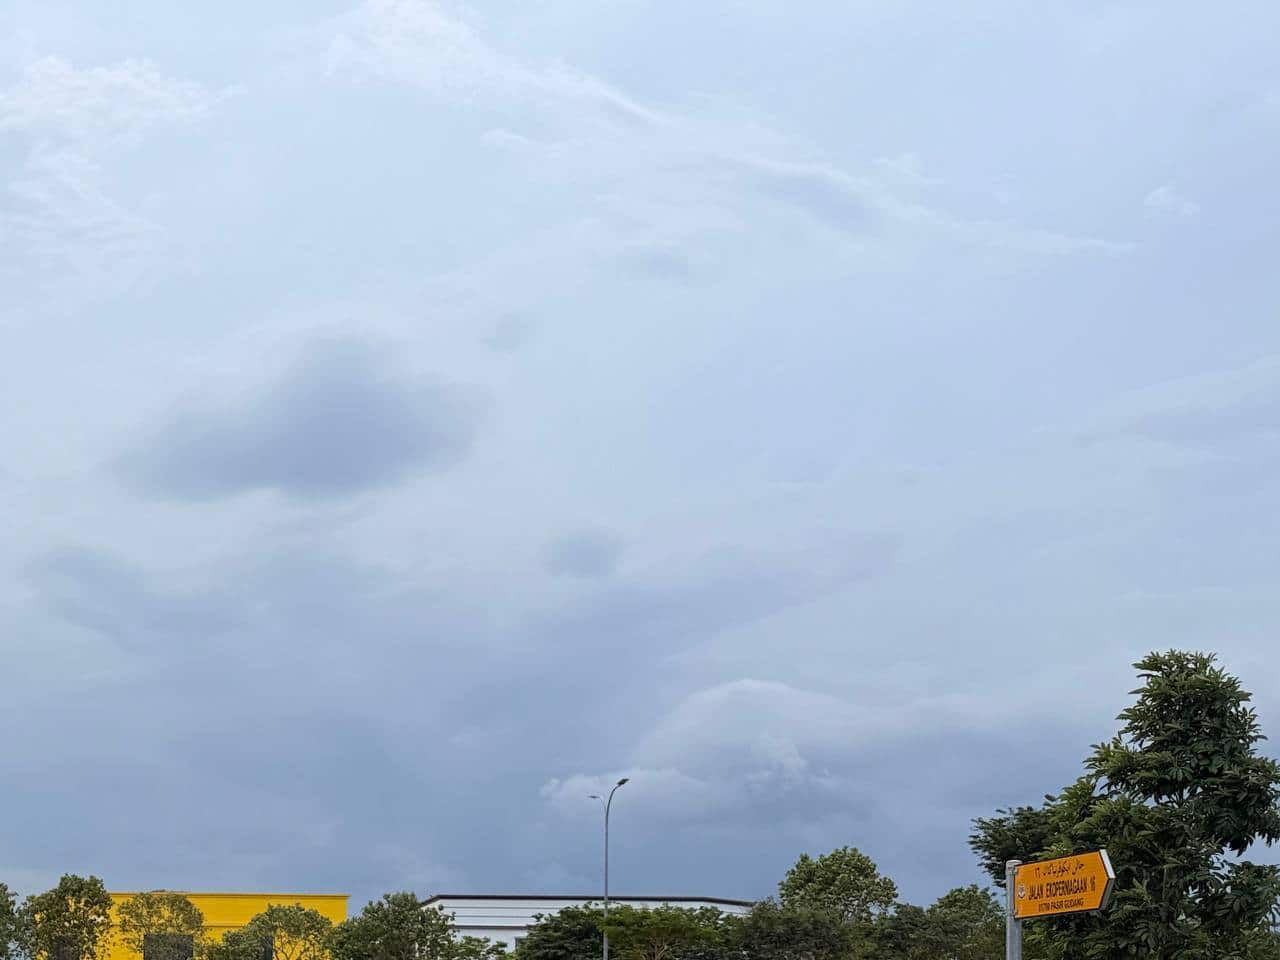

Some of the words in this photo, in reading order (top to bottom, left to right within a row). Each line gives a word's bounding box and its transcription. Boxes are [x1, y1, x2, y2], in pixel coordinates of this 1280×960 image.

[1029, 883, 1043, 900] JALAN
[1051, 900, 1063, 910] PASIR
[1064, 897, 1084, 909] GUDANG
